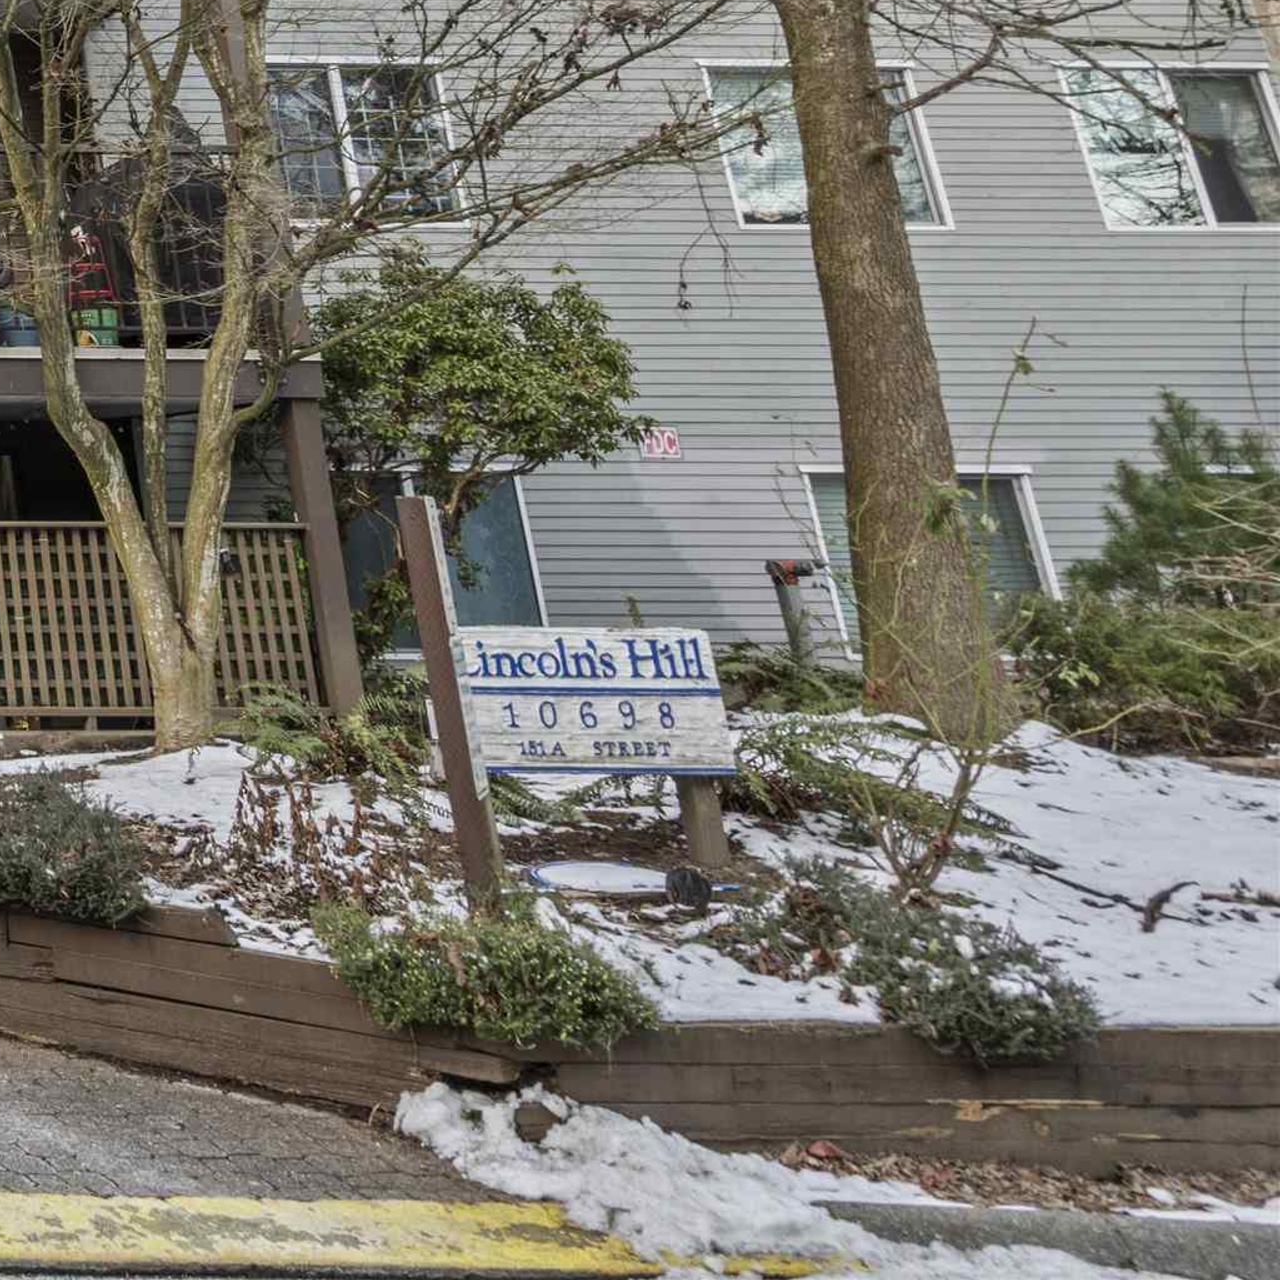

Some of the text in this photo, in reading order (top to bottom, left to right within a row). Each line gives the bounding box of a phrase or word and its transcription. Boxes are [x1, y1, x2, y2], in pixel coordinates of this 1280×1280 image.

[620, 637, 710, 679] Hill
[502, 700, 675, 729] 10698
[593, 740, 671, 757] STREET
